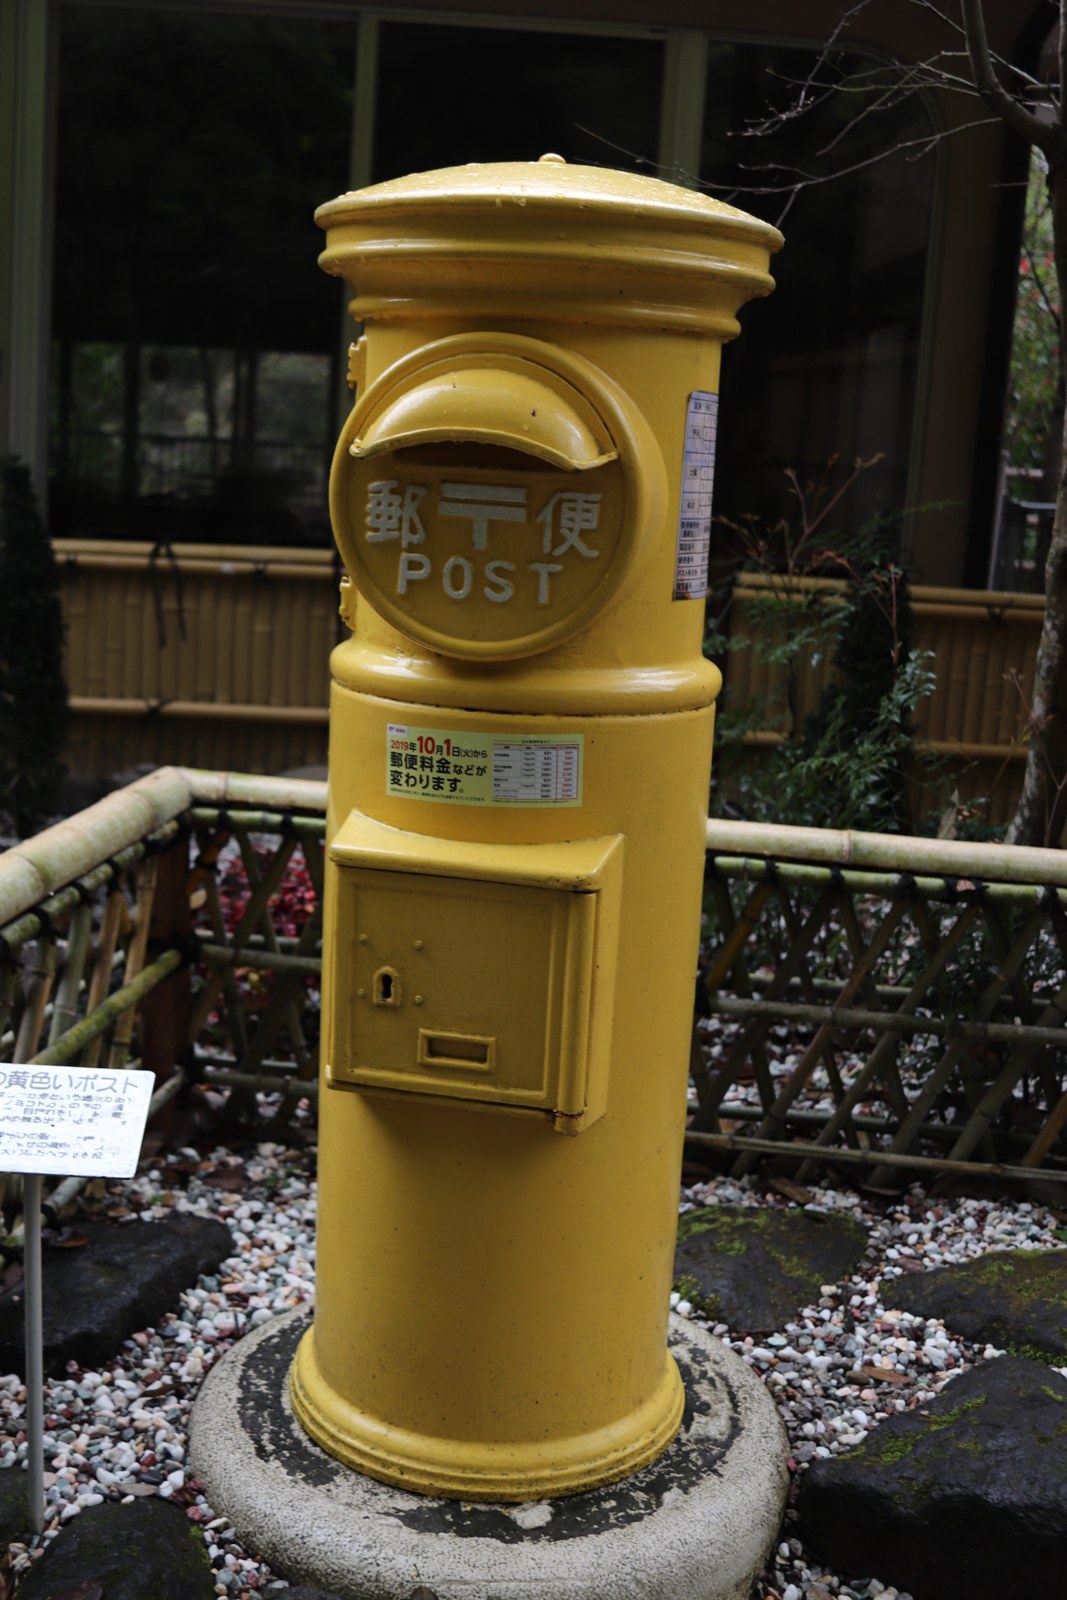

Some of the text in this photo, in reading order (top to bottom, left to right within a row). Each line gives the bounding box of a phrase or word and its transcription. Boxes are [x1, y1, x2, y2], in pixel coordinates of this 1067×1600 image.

[396, 552, 564, 605] POST
[390, 751, 488, 777] 郵便料金などが
[390, 769, 464, 794] 変わります。
